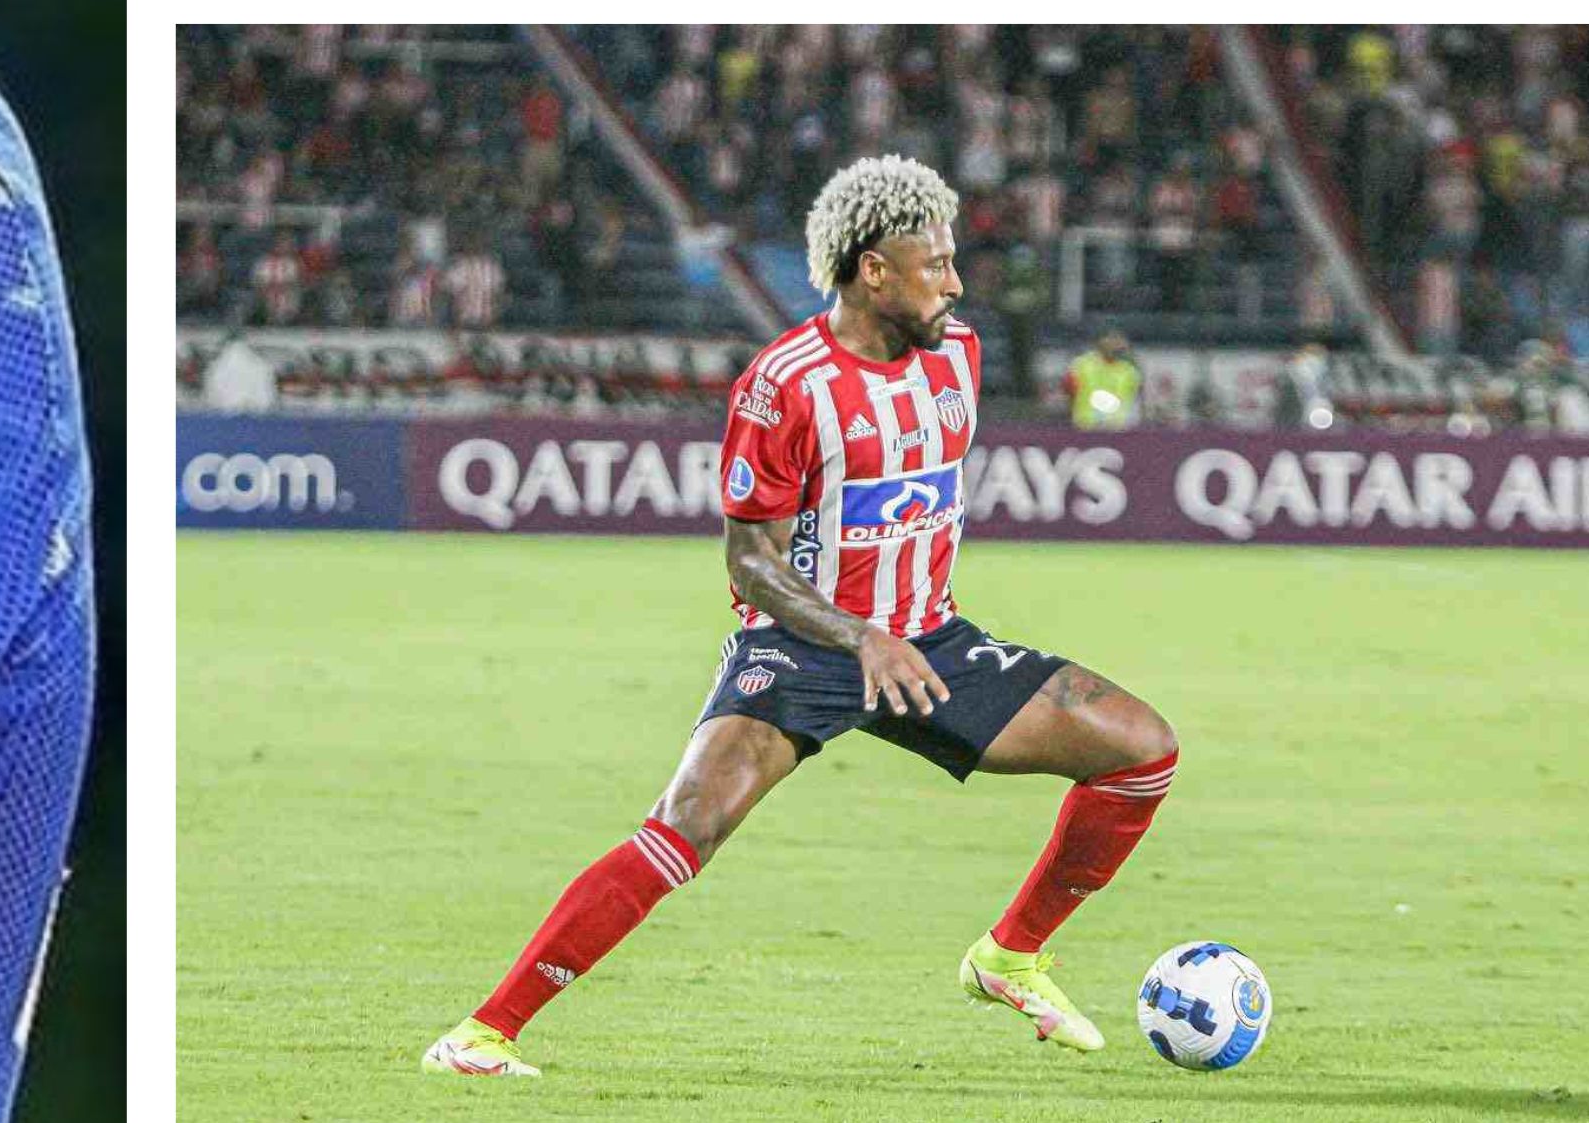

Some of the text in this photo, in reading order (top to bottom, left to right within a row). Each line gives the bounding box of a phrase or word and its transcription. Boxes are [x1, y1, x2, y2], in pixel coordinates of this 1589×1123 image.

[438, 439, 722, 529] QATAR
[895, 429, 929, 452] AGUILA
[1175, 448, 1589, 541] QATAR AI
